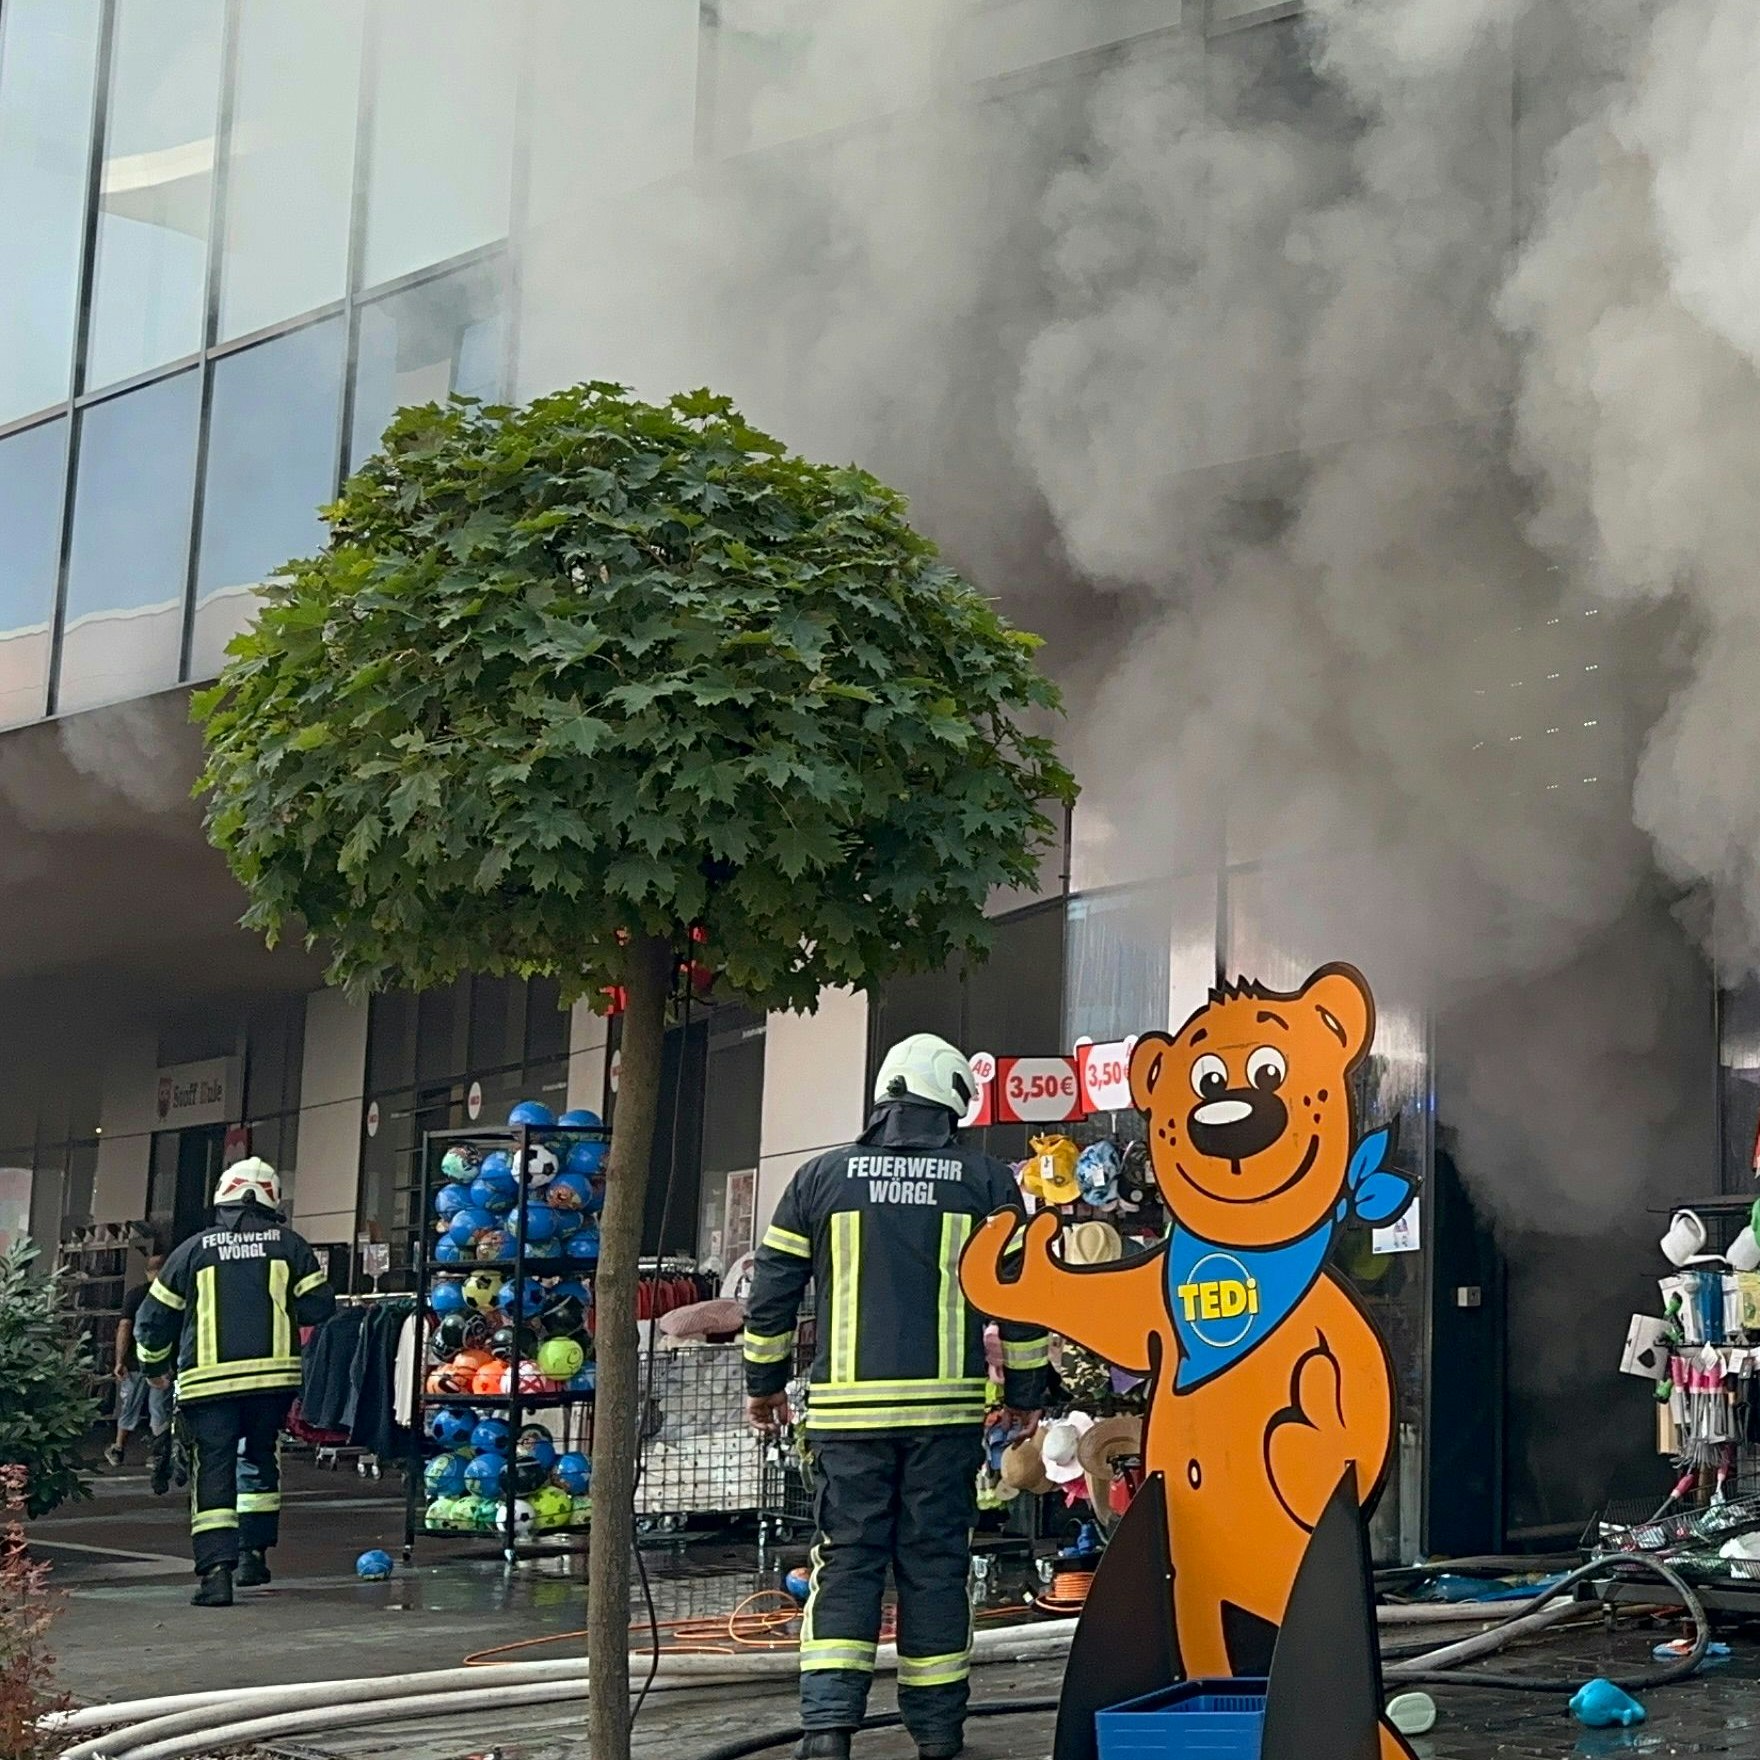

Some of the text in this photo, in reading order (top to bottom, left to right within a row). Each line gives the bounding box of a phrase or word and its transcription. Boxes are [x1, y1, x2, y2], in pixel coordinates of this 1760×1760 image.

[972, 1058, 993, 1078] AB
[1009, 1074, 1075, 1104] 3,50€
[846, 1155, 963, 1182] FEUERWEHR
[868, 1176, 938, 1206] WÖRGL
[202, 1229, 281, 1249] FEUERWEHR
[1177, 1277, 1260, 1323] TEDi
